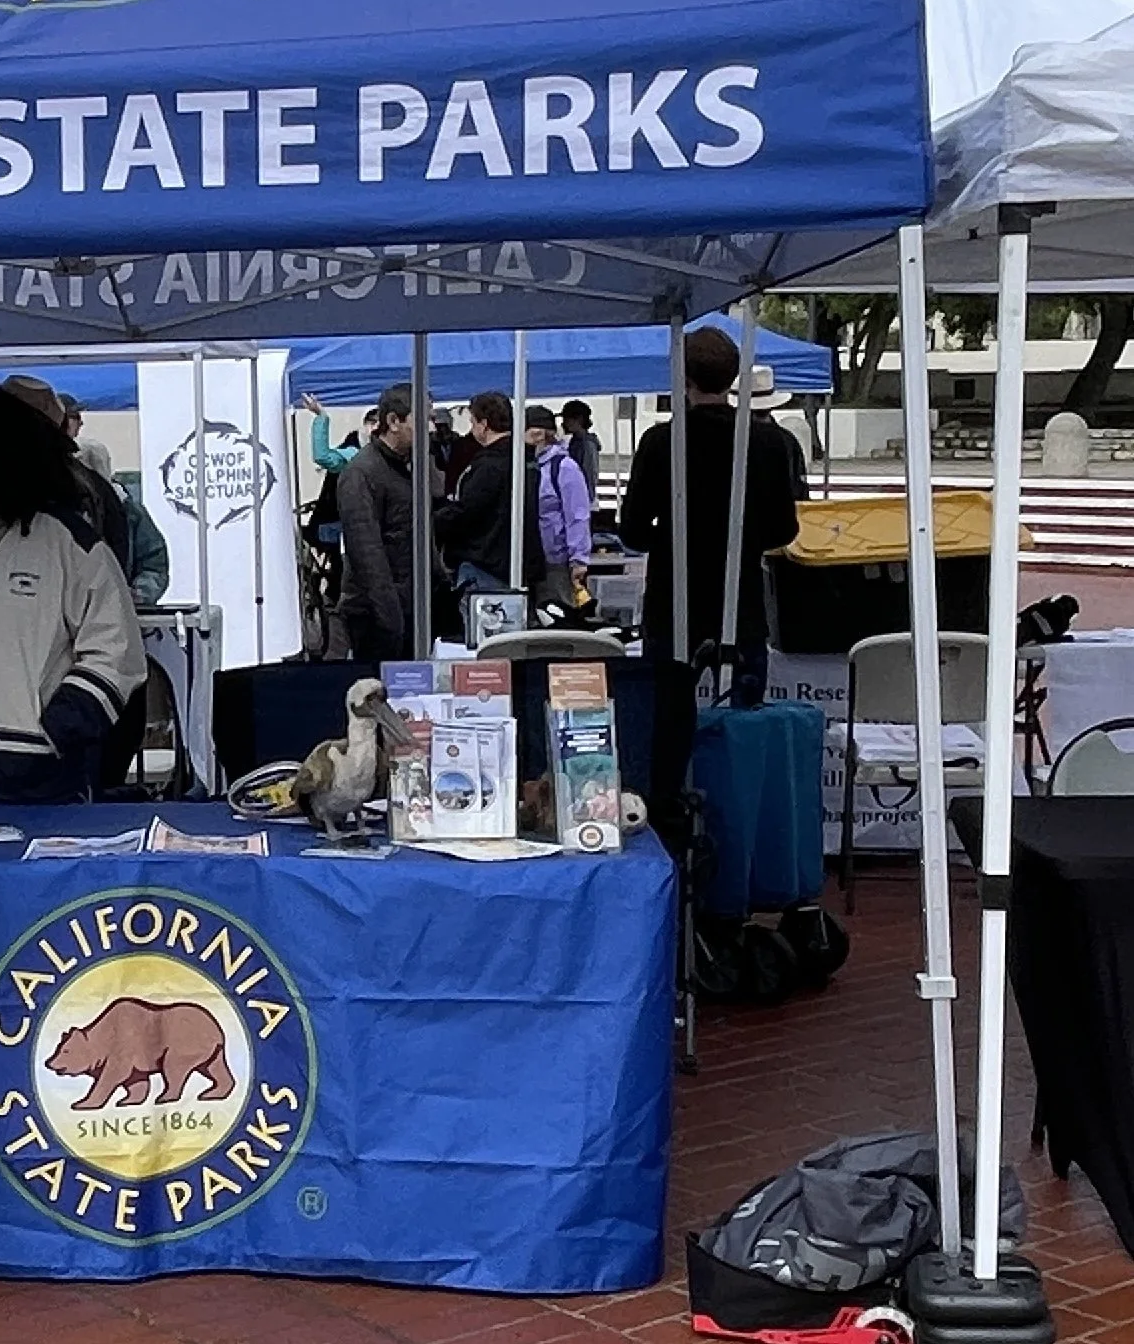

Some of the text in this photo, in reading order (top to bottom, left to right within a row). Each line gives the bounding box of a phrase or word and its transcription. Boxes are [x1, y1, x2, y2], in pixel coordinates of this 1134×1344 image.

[358, 66, 765, 182] PARKS
[185, 468, 251, 484] DLPHIN
[175, 483, 263, 499] SACTUAR
[76, 1111, 214, 1138] SINCE 1864
[165, 1082, 298, 1222] PARKS
